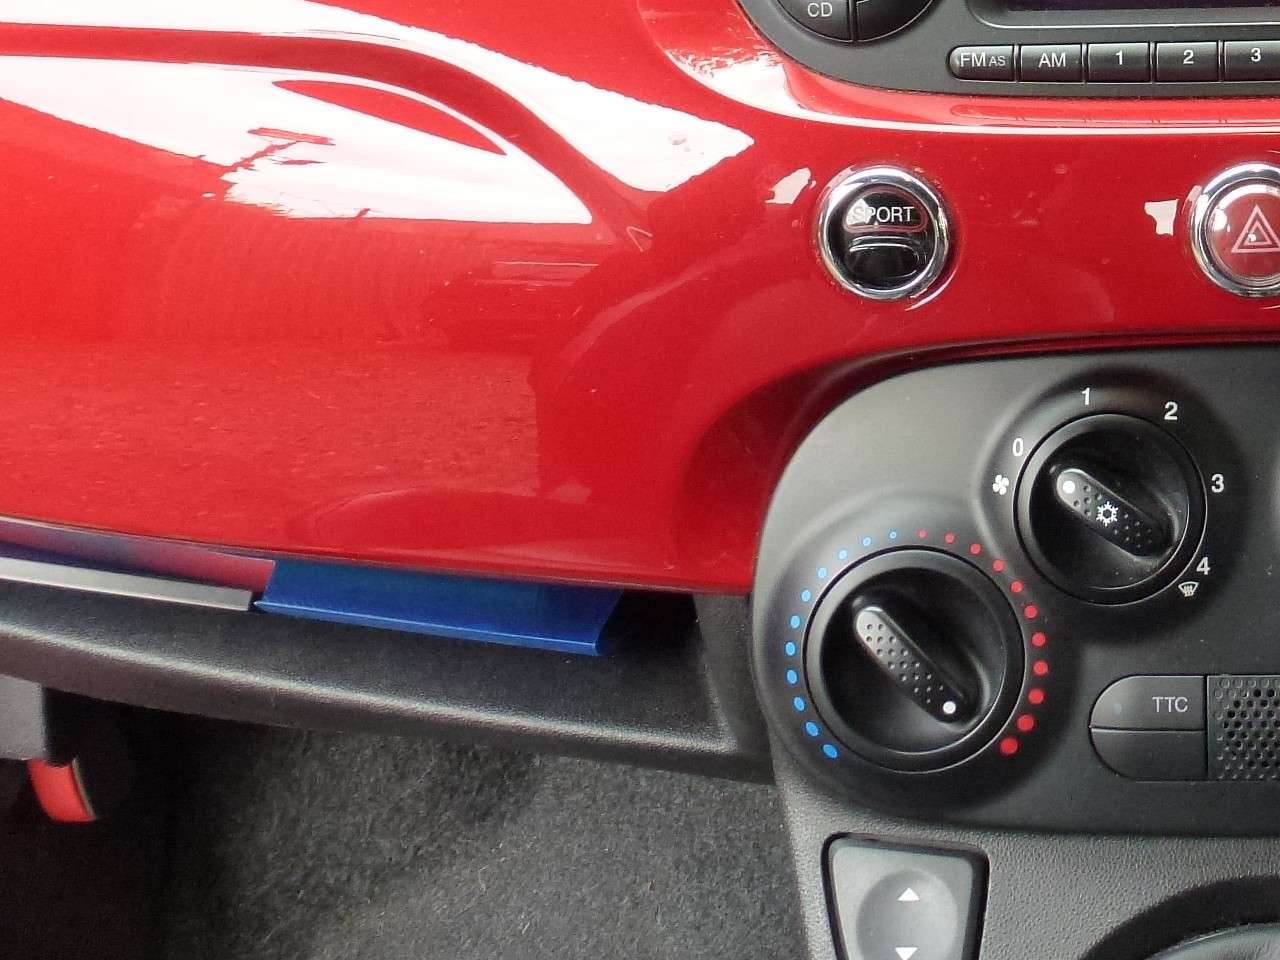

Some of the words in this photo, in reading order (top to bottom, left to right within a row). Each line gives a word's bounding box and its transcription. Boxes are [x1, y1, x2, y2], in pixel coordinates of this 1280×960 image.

[807, 2, 833, 18] CD
[960, 52, 986, 67] FM
[988, 55, 1006, 67] AS
[1038, 52, 1066, 67] AM
[1115, 51, 1125, 66] 1
[1182, 49, 1194, 65] 2
[1250, 47, 1262, 62] 3
[852, 205, 915, 224] SPORT
[1081, 387, 1091, 406] 1
[1163, 401, 1178, 420] 2
[1012, 437, 1024, 457] 0
[1211, 473, 1225, 493] 3
[1196, 556, 1211, 575] 4
[1152, 696, 1188, 713] TTC
